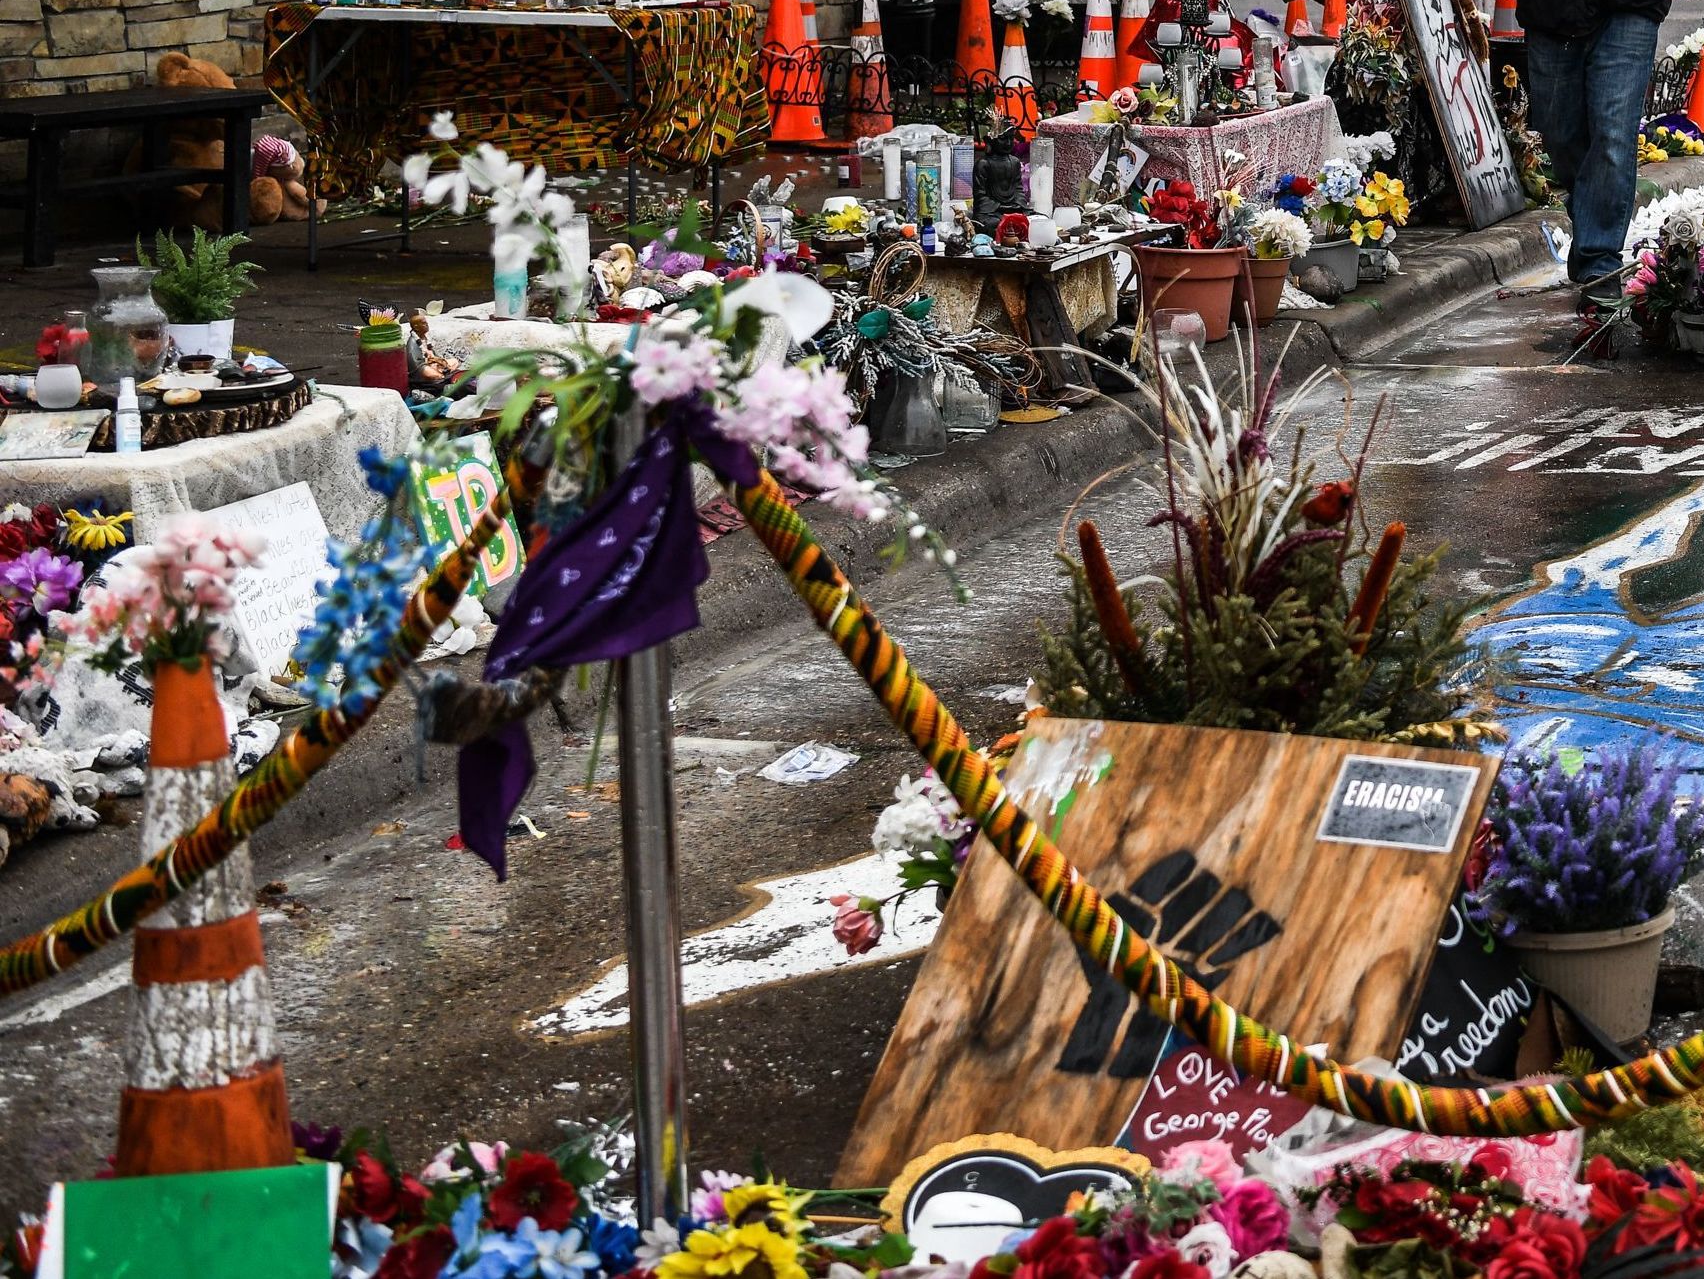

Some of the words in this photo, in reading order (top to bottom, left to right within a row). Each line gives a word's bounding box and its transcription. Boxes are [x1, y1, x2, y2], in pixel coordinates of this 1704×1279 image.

[1342, 779, 1445, 812] ERACISM
[1153, 1051, 1236, 1106] LOVE
[1143, 1109, 1241, 1142] George
